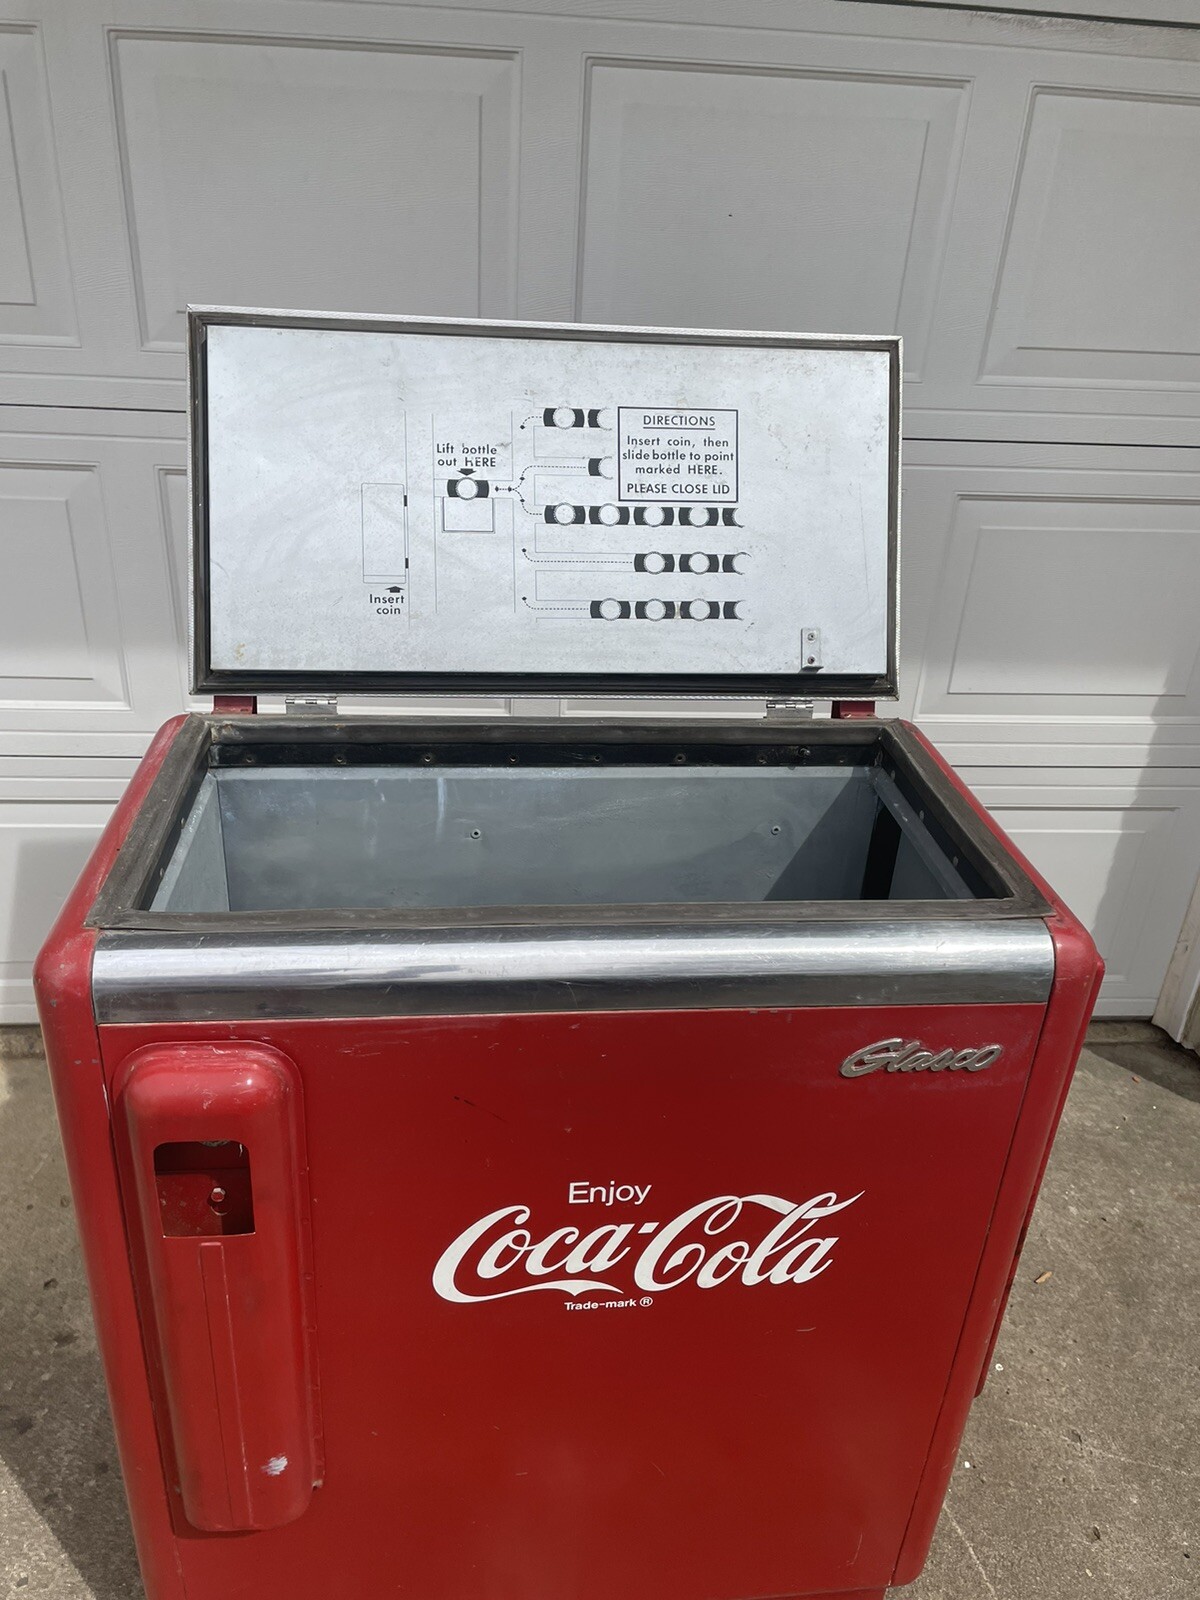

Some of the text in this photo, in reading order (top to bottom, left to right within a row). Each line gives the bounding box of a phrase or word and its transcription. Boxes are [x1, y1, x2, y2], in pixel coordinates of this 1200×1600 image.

[643, 415, 716, 426] DIRECTIONS
[626, 435, 729, 448] Insert coin, then
[436, 443, 497, 455] Lift bottle
[437, 456, 496, 467] out HERE
[622, 449, 735, 463] slide bottle to point
[634, 463, 723, 475] marked HERE.
[627, 483, 731, 494] PLEASE CLOSE LID
[369, 593, 405, 604] Insert
[376, 604, 401, 615] coin
[839, 1037, 1001, 1078] Glasco
[568, 1181, 652, 1206] Enjoy
[432, 1190, 866, 1304] Coca-Cola
[564, 1299, 637, 1311] Trade-mark
